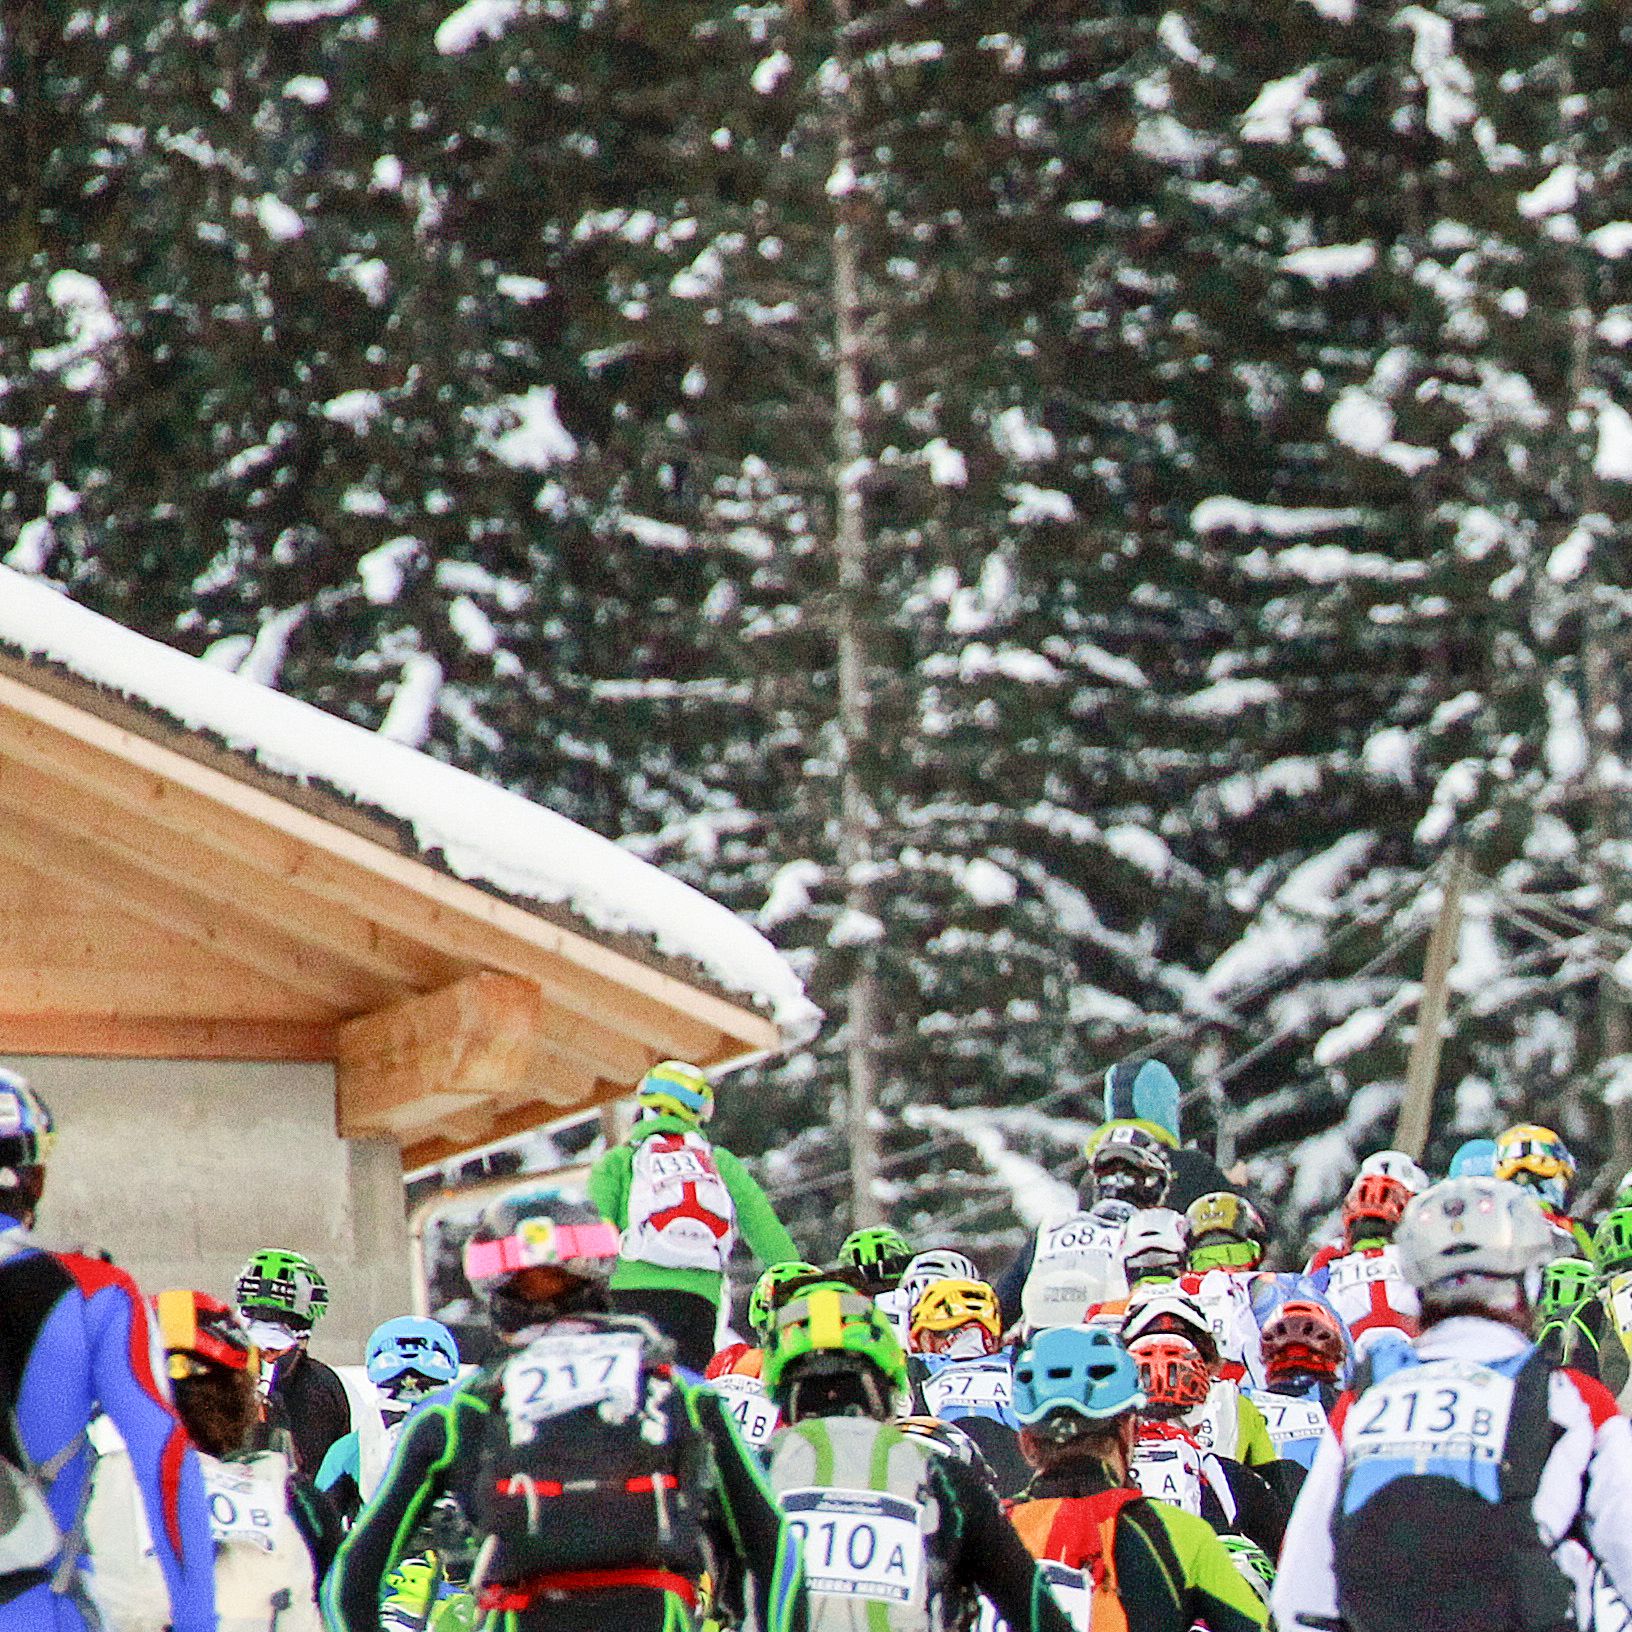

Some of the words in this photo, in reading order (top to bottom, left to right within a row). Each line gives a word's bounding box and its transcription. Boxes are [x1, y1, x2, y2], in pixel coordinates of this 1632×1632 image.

[519, 1355, 619, 1405] 217
[939, 1375, 974, 1398] 57
[992, 1381, 1008, 1397] A
[1358, 1388, 1459, 1436] 213
[1471, 1407, 1494, 1438] B
[751, 1415, 767, 1438] B
[1162, 1473, 1178, 1493] A
[251, 1507, 271, 1527] B
[884, 1543, 907, 1577] A
